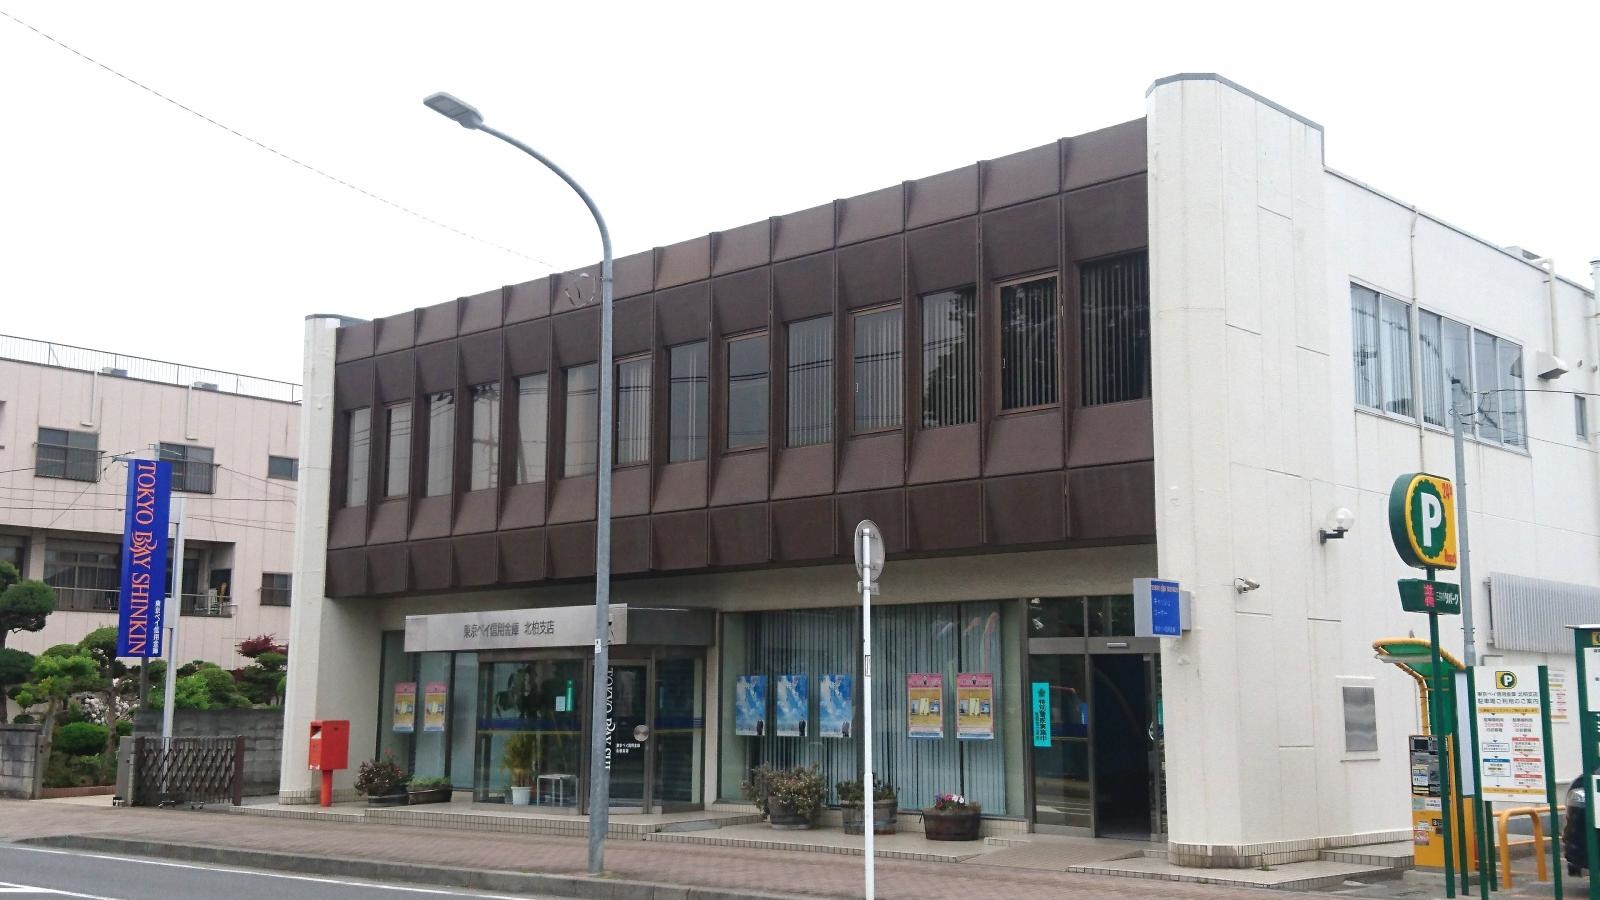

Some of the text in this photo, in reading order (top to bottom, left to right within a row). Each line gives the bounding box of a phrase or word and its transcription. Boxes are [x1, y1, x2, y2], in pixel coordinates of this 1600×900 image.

[1420, 492, 1442, 548] P
[128, 461, 158, 655] TOKYO BAY SHINKIN
[152, 599, 161, 655] 東京ベイ信用金庫
[463, 619, 555, 639] 東京ベイ信用金庫 北柏支店
